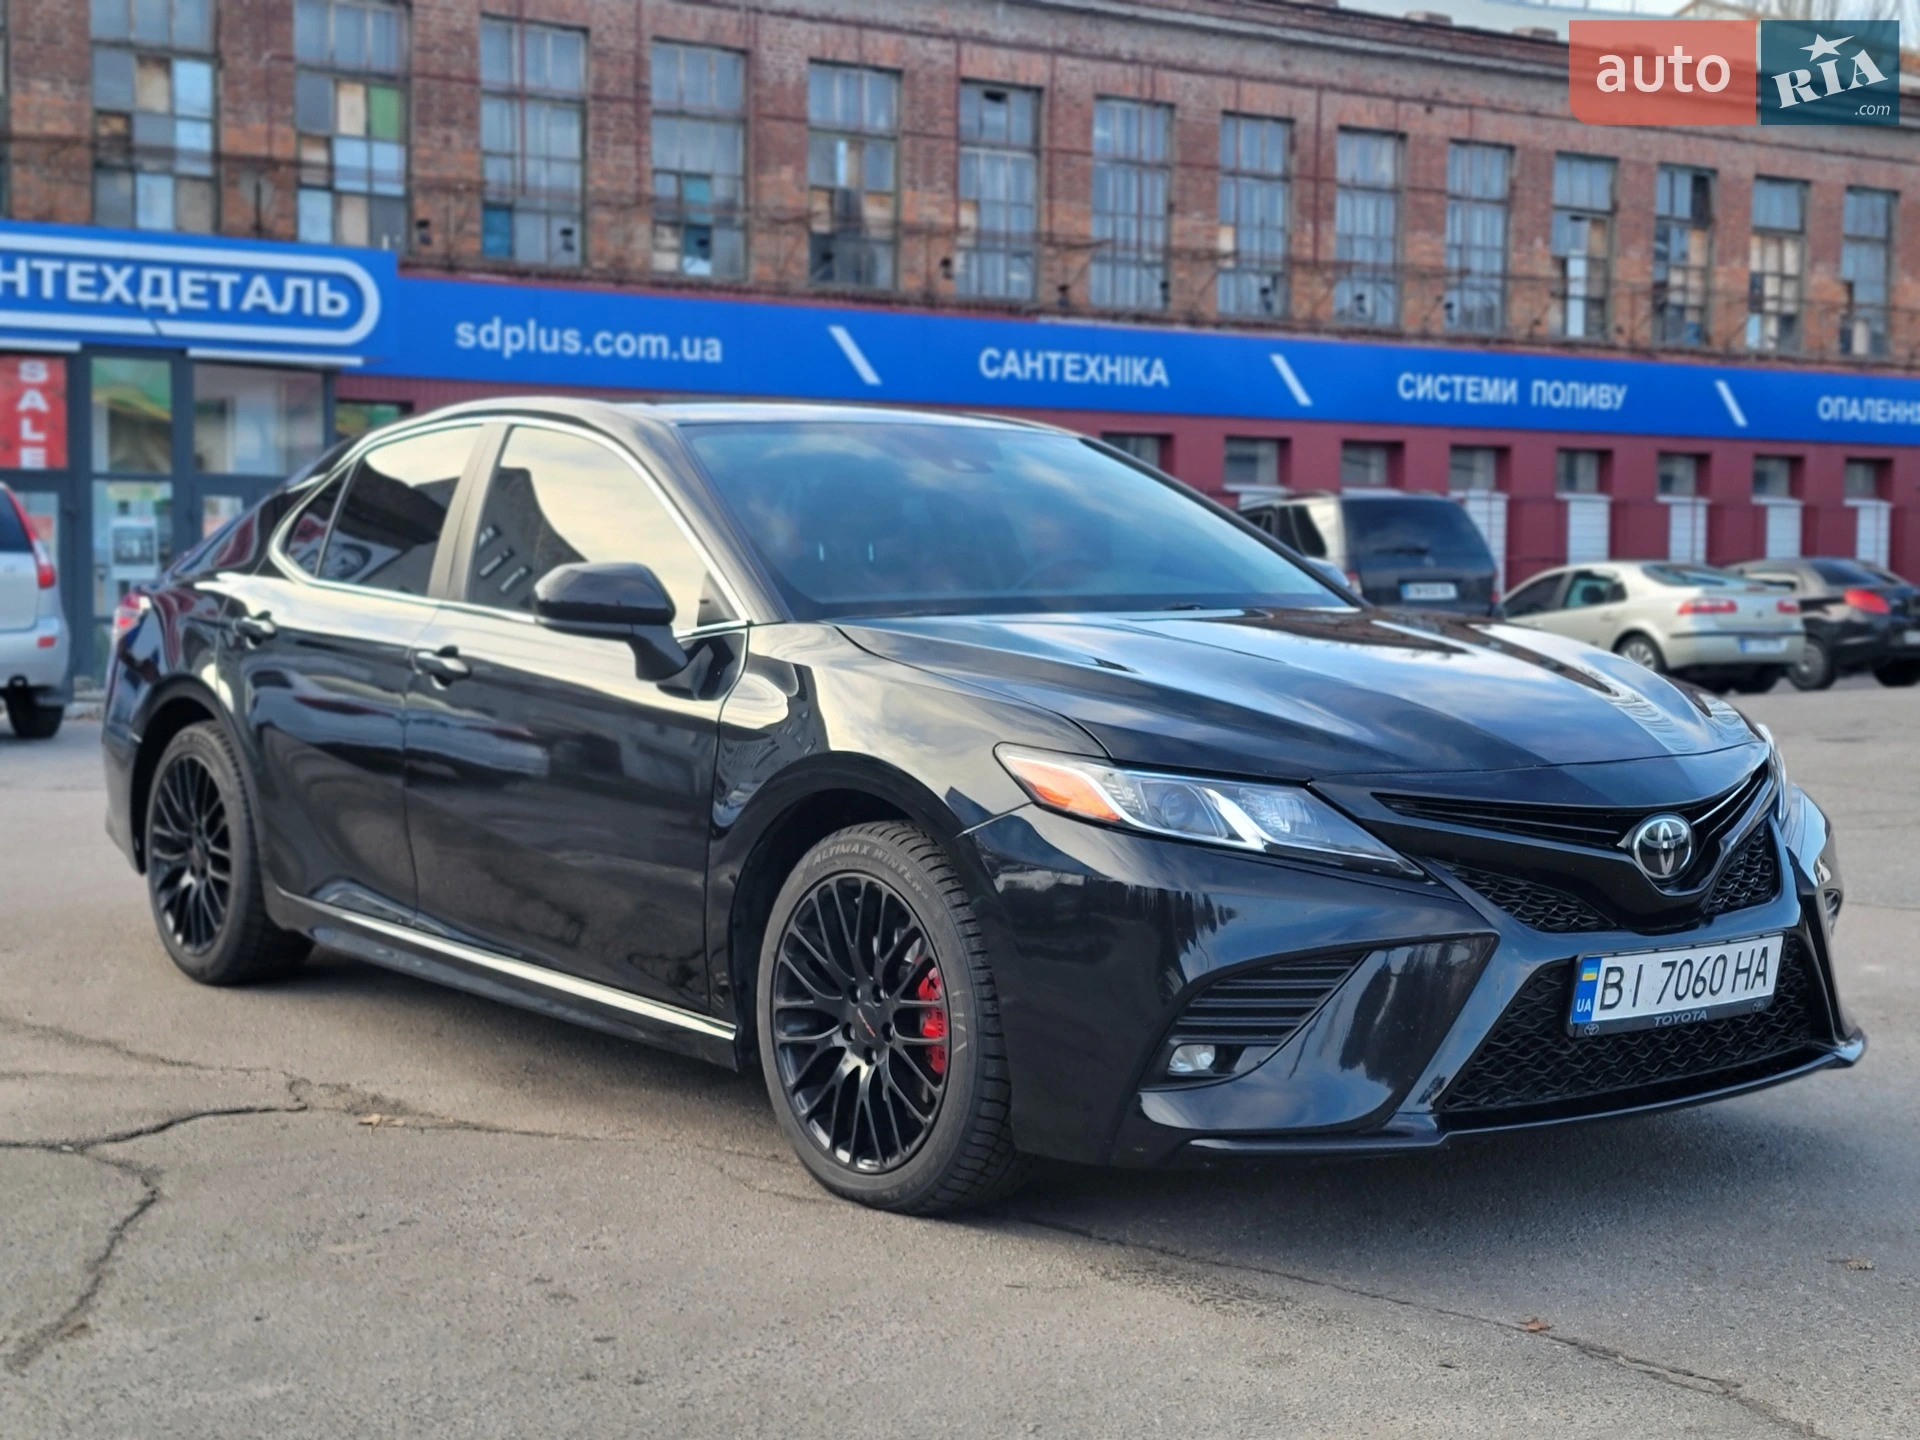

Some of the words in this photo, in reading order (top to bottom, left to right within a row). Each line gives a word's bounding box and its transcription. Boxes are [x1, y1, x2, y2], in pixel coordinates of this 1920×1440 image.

[0, 256, 349, 317] НТЕХДЕТАЛЬ
[455, 316, 722, 362] sdplus.com.ua
[979, 346, 1169, 387] САНТЕХНІКА
[1397, 372, 1518, 405] СИСТЕМИ
[1531, 379, 1627, 411] ПОЛИВУ
[17, 359, 49, 469] SALE
[1599, 964, 1643, 1011] BI
[1656, 953, 1728, 1005] 7060
[1731, 946, 1769, 993] HA
[1576, 998, 1591, 1013] UA
[1654, 1010, 1708, 1027] TOYOTA
